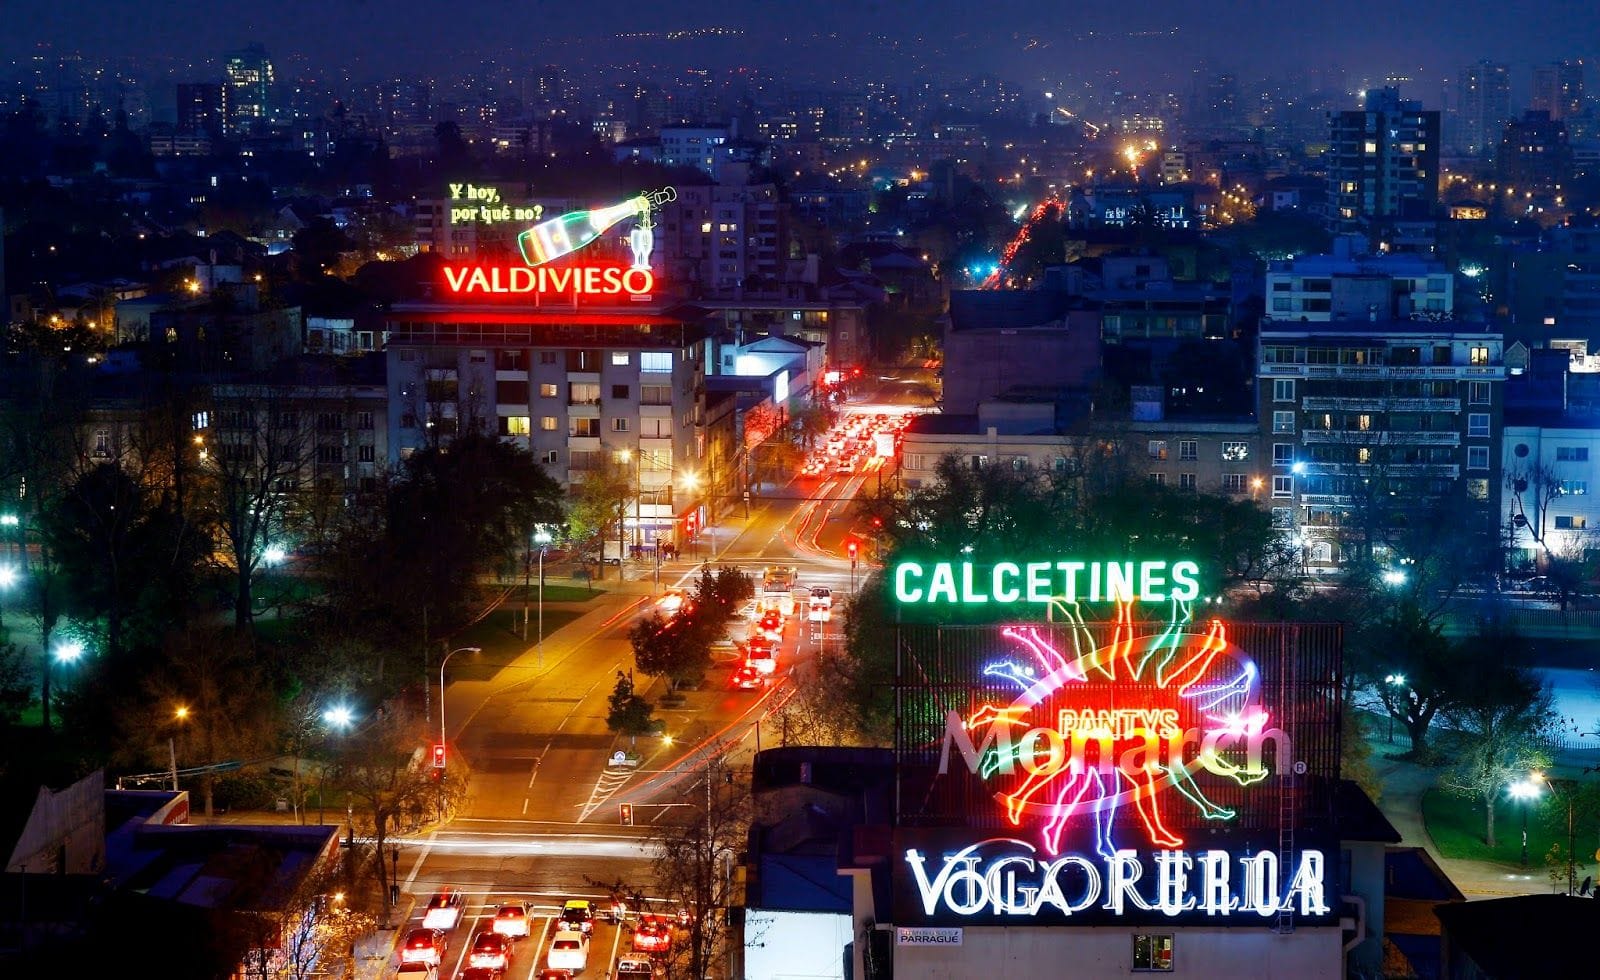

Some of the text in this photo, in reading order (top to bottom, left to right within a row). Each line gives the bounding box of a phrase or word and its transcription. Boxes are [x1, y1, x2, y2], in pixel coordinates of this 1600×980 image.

[449, 183, 500, 203] Y hoy,
[451, 203, 543, 224] por qué no?
[443, 266, 654, 294] VALDIVIESO
[894, 561, 1200, 602] CALCETINES
[937, 703, 1291, 776] Monarch
[1058, 708, 1180, 741] PANTYS
